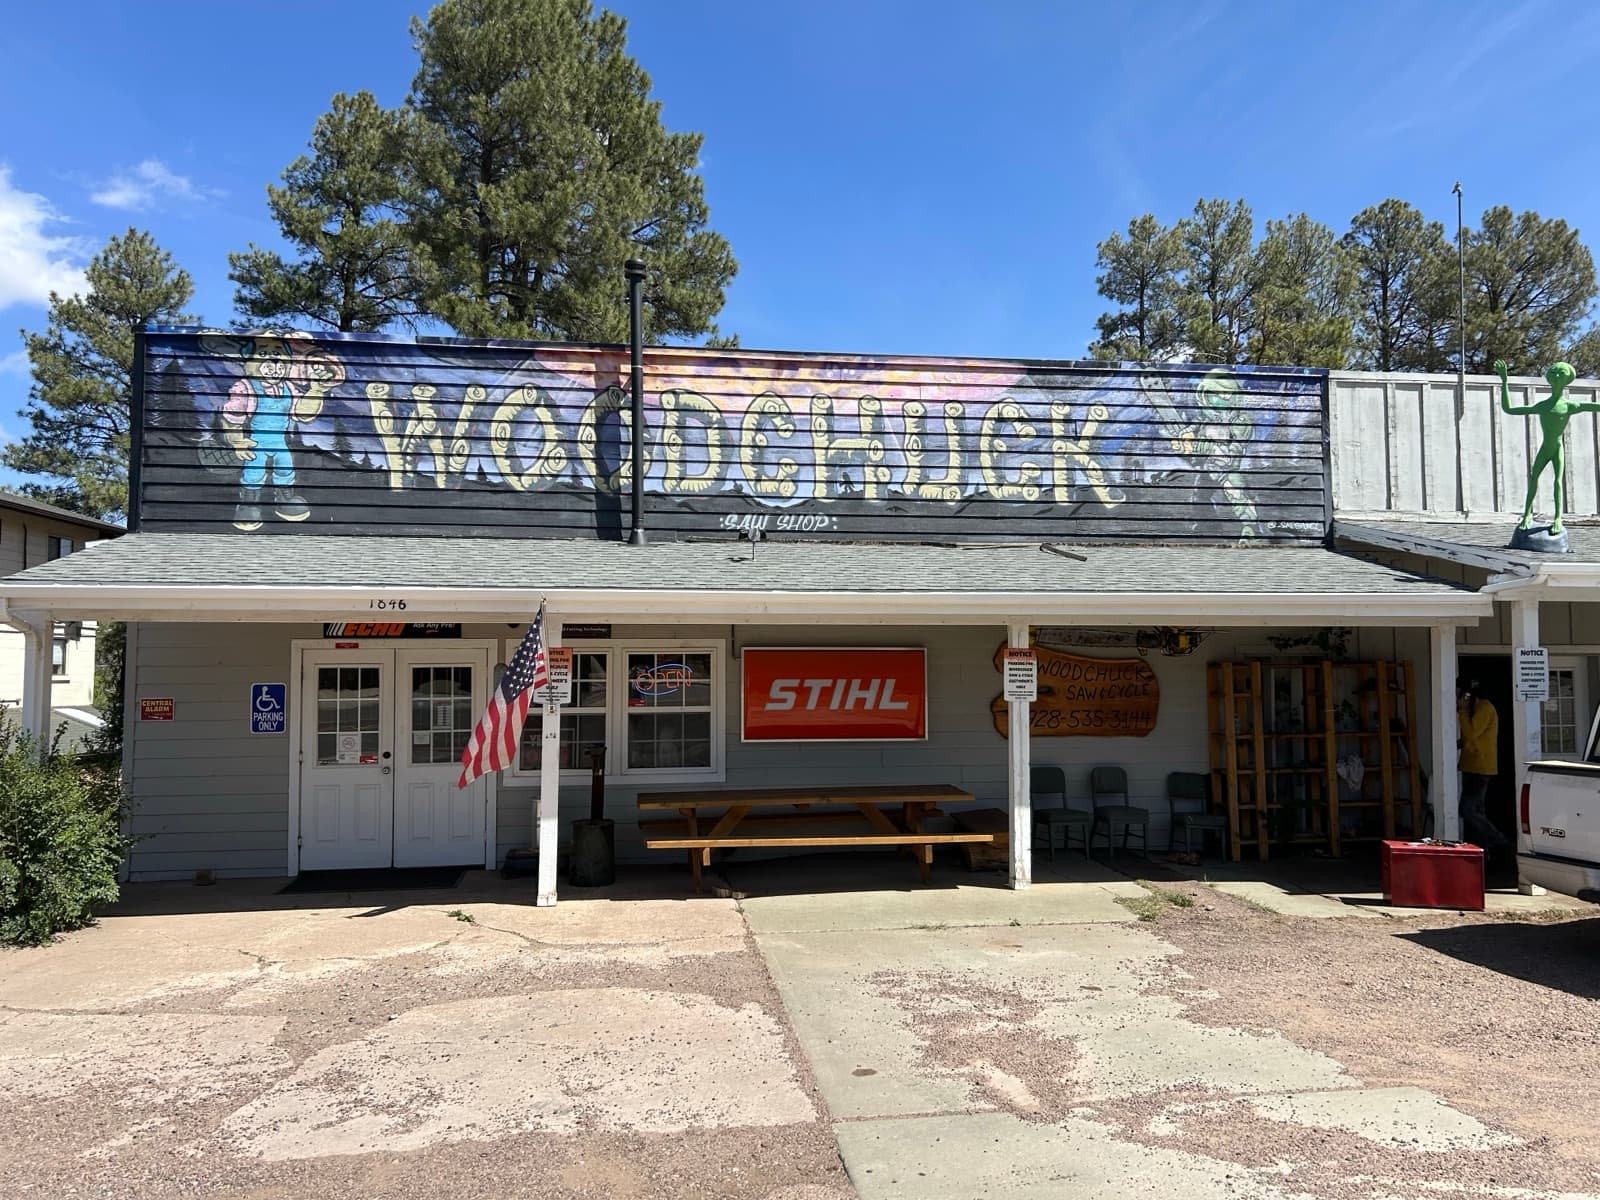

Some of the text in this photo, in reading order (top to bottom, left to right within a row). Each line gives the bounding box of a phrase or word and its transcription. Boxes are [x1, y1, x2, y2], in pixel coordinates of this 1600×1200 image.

[366, 382, 1126, 508] WOODCHUCK
[369, 599, 407, 610] 1846
[635, 669, 692, 691] OPEN
[1037, 660, 1153, 685] WOODCHUCK
[764, 678, 910, 711] STIHL
[1065, 684, 1097, 701] SAW
[1107, 683, 1150, 699] CYCLE
[253, 712, 284, 722] PARKING
[258, 721, 278, 731] ONLY
